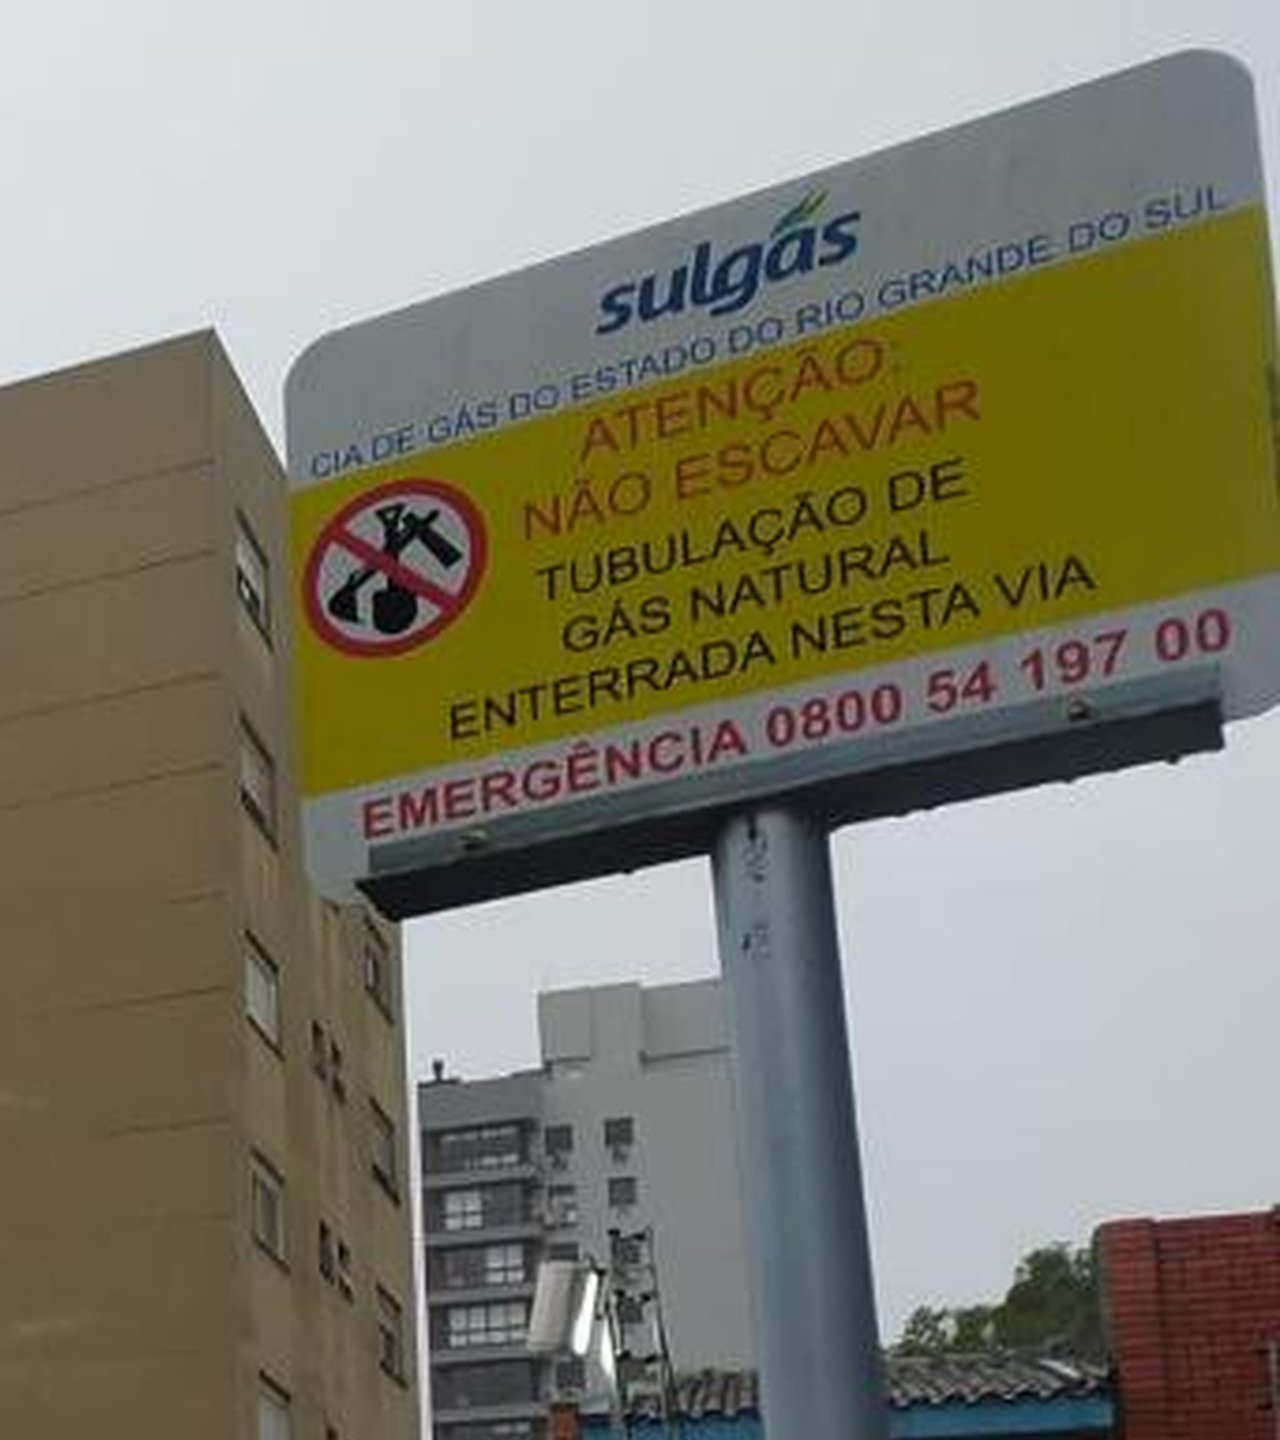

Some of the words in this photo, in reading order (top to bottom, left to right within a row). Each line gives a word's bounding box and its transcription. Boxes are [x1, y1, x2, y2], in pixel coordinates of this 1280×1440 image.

[311, 446, 363, 478] CIA
[371, 424, 416, 458] DE
[428, 398, 498, 444] GÁS
[510, 383, 559, 421] DO
[571, 336, 716, 401] ESTADO
[728, 317, 783, 353] DO
[795, 290, 865, 333] RIO
[877, 235, 1053, 304] GRANDE
[1068, 211, 1130, 252] DO
[1144, 185, 1228, 231] SUL
[523, 471, 650, 541] NÃO
[675, 379, 982, 502] ESCAVAR
[538, 485, 868, 602] TUBULAÇÃO
[888, 457, 970, 512] DE
[449, 631, 776, 741] ENTERRADA
[791, 583, 981, 658] NESTA
[994, 554, 1097, 608] VIA
[562, 594, 671, 653] GÁS
[690, 530, 950, 624] NATURAL
[361, 719, 747, 839] EMERGÊNCIA
[766, 682, 902, 748] 0800
[926, 660, 997, 714] 54
[1021, 628, 1128, 691] 197
[1155, 608, 1232, 662] 00
